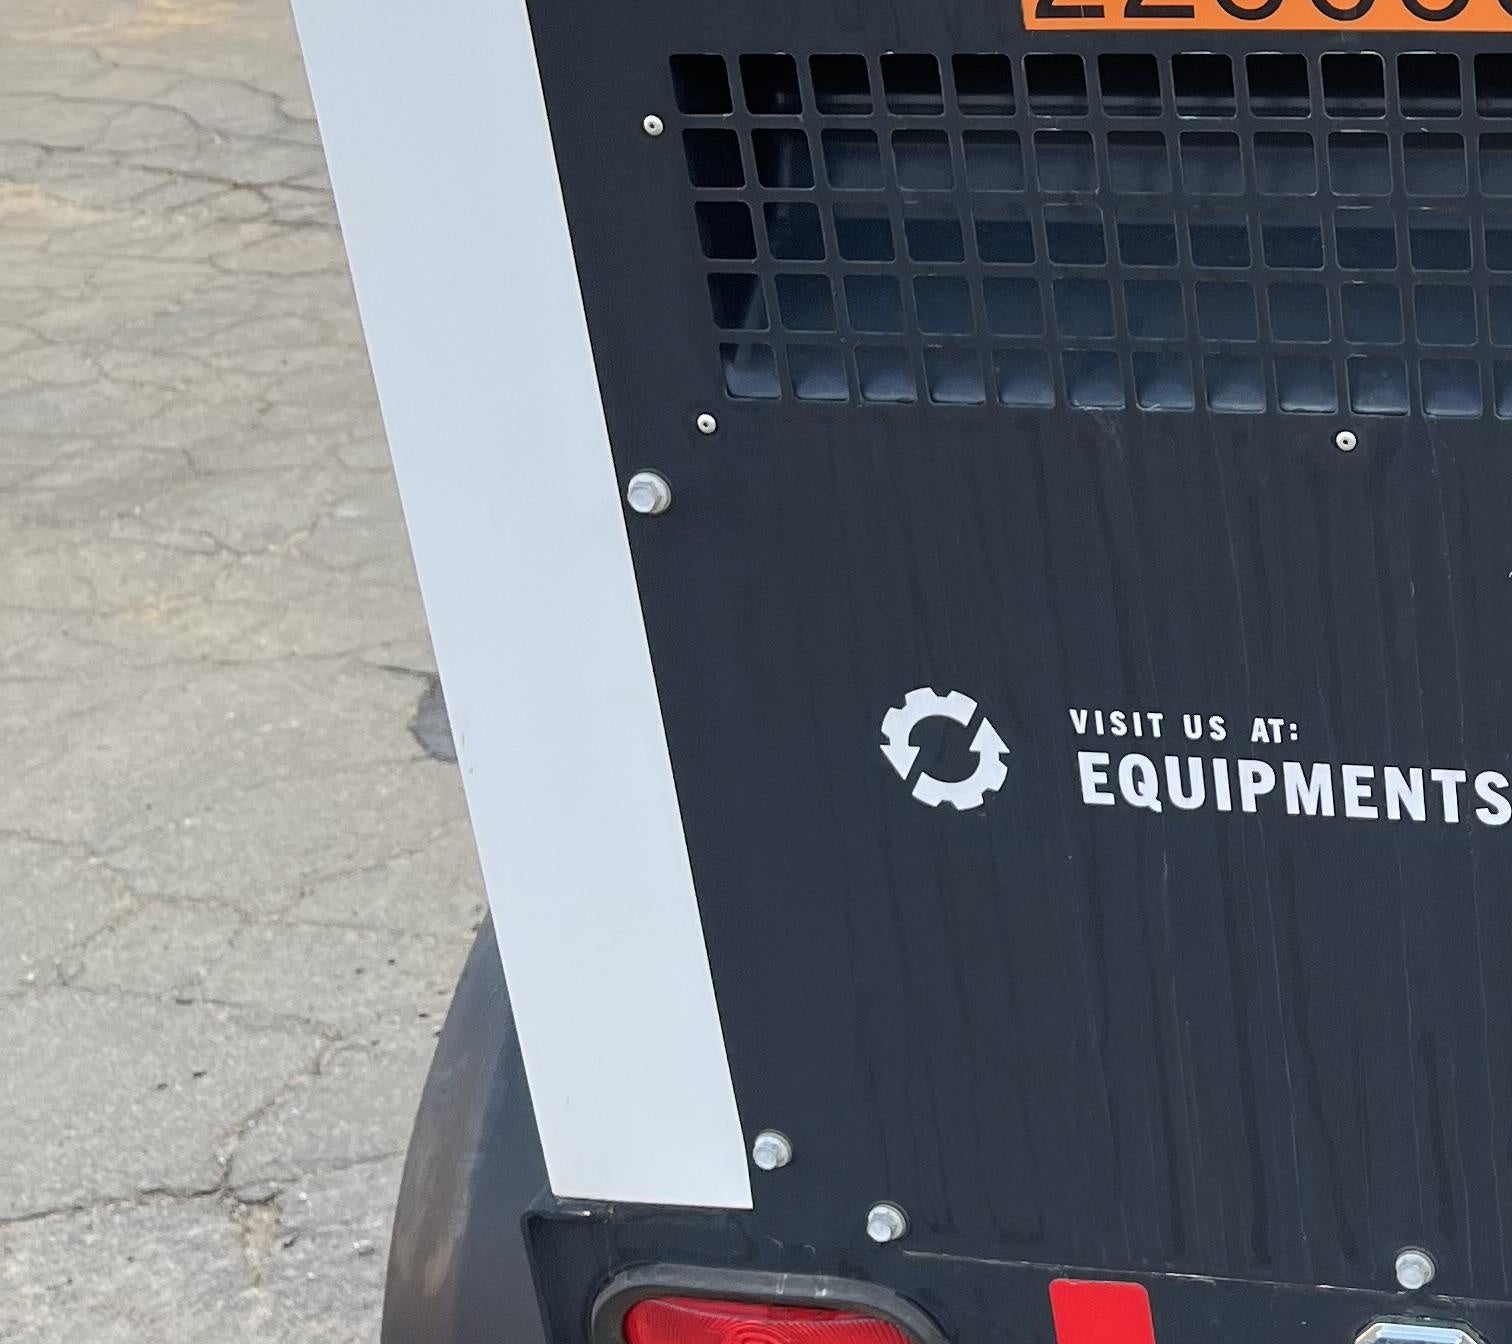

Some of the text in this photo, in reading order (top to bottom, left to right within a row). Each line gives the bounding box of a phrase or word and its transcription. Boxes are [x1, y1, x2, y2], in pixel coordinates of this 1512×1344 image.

[1069, 708, 1298, 744] VISIT US AT:
